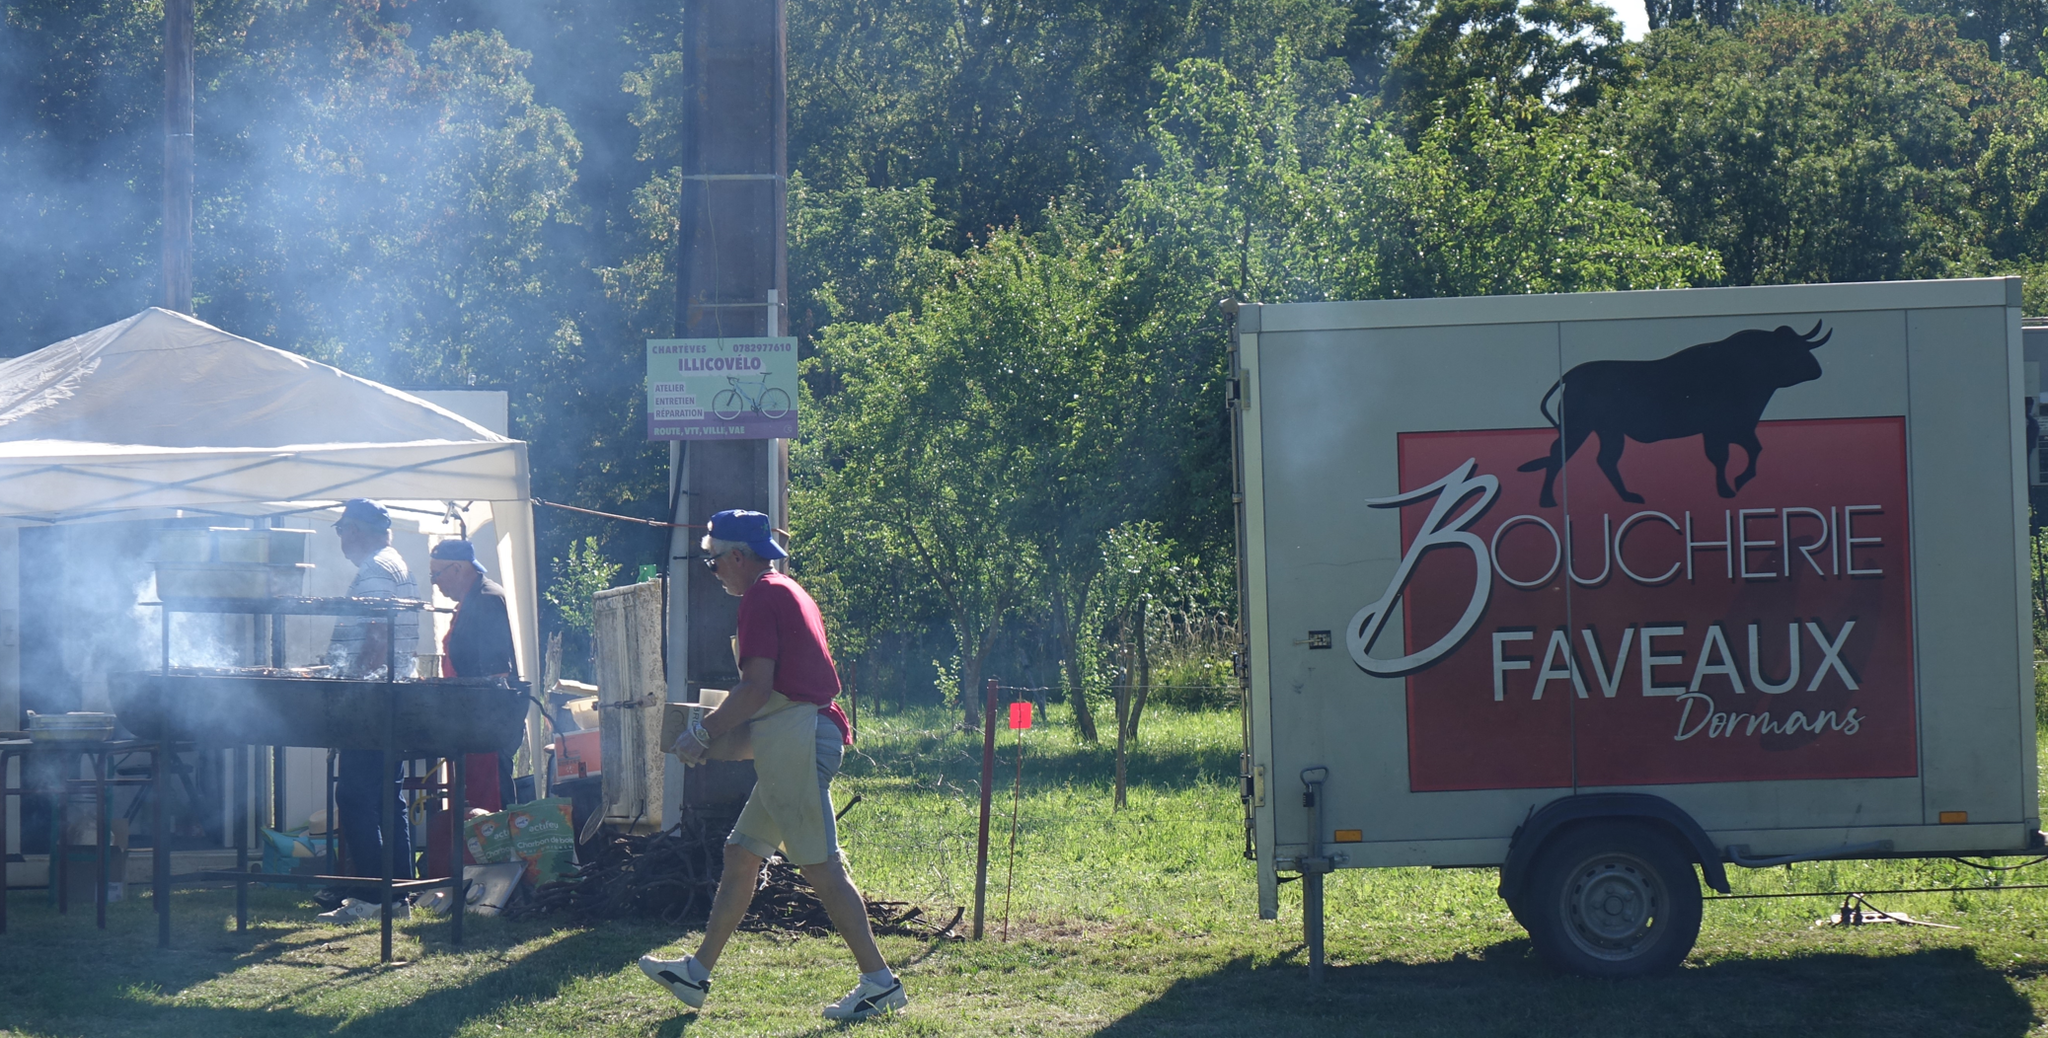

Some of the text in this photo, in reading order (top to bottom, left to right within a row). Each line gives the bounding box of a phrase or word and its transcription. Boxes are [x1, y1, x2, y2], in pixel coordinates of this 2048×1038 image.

[652, 343, 791, 354] CHARTÈVES 0782977610
[678, 354, 761, 371] ILLICOVÉLO
[655, 383, 685, 392] ATELIER
[655, 397, 695, 406] ENTRETIEN
[655, 408, 703, 418] RÉPARATION
[653, 427, 684, 436] ROUTE,
[684, 426, 702, 436] VTT,
[729, 426, 745, 434] VAE
[1346, 457, 1884, 674] BOUCHERIE
[1491, 621, 1860, 702] FAVEAUX
[1674, 692, 1866, 742] Dormans
[529, 820, 559, 832] actifeu
[517, 838, 549, 849] Charbon
